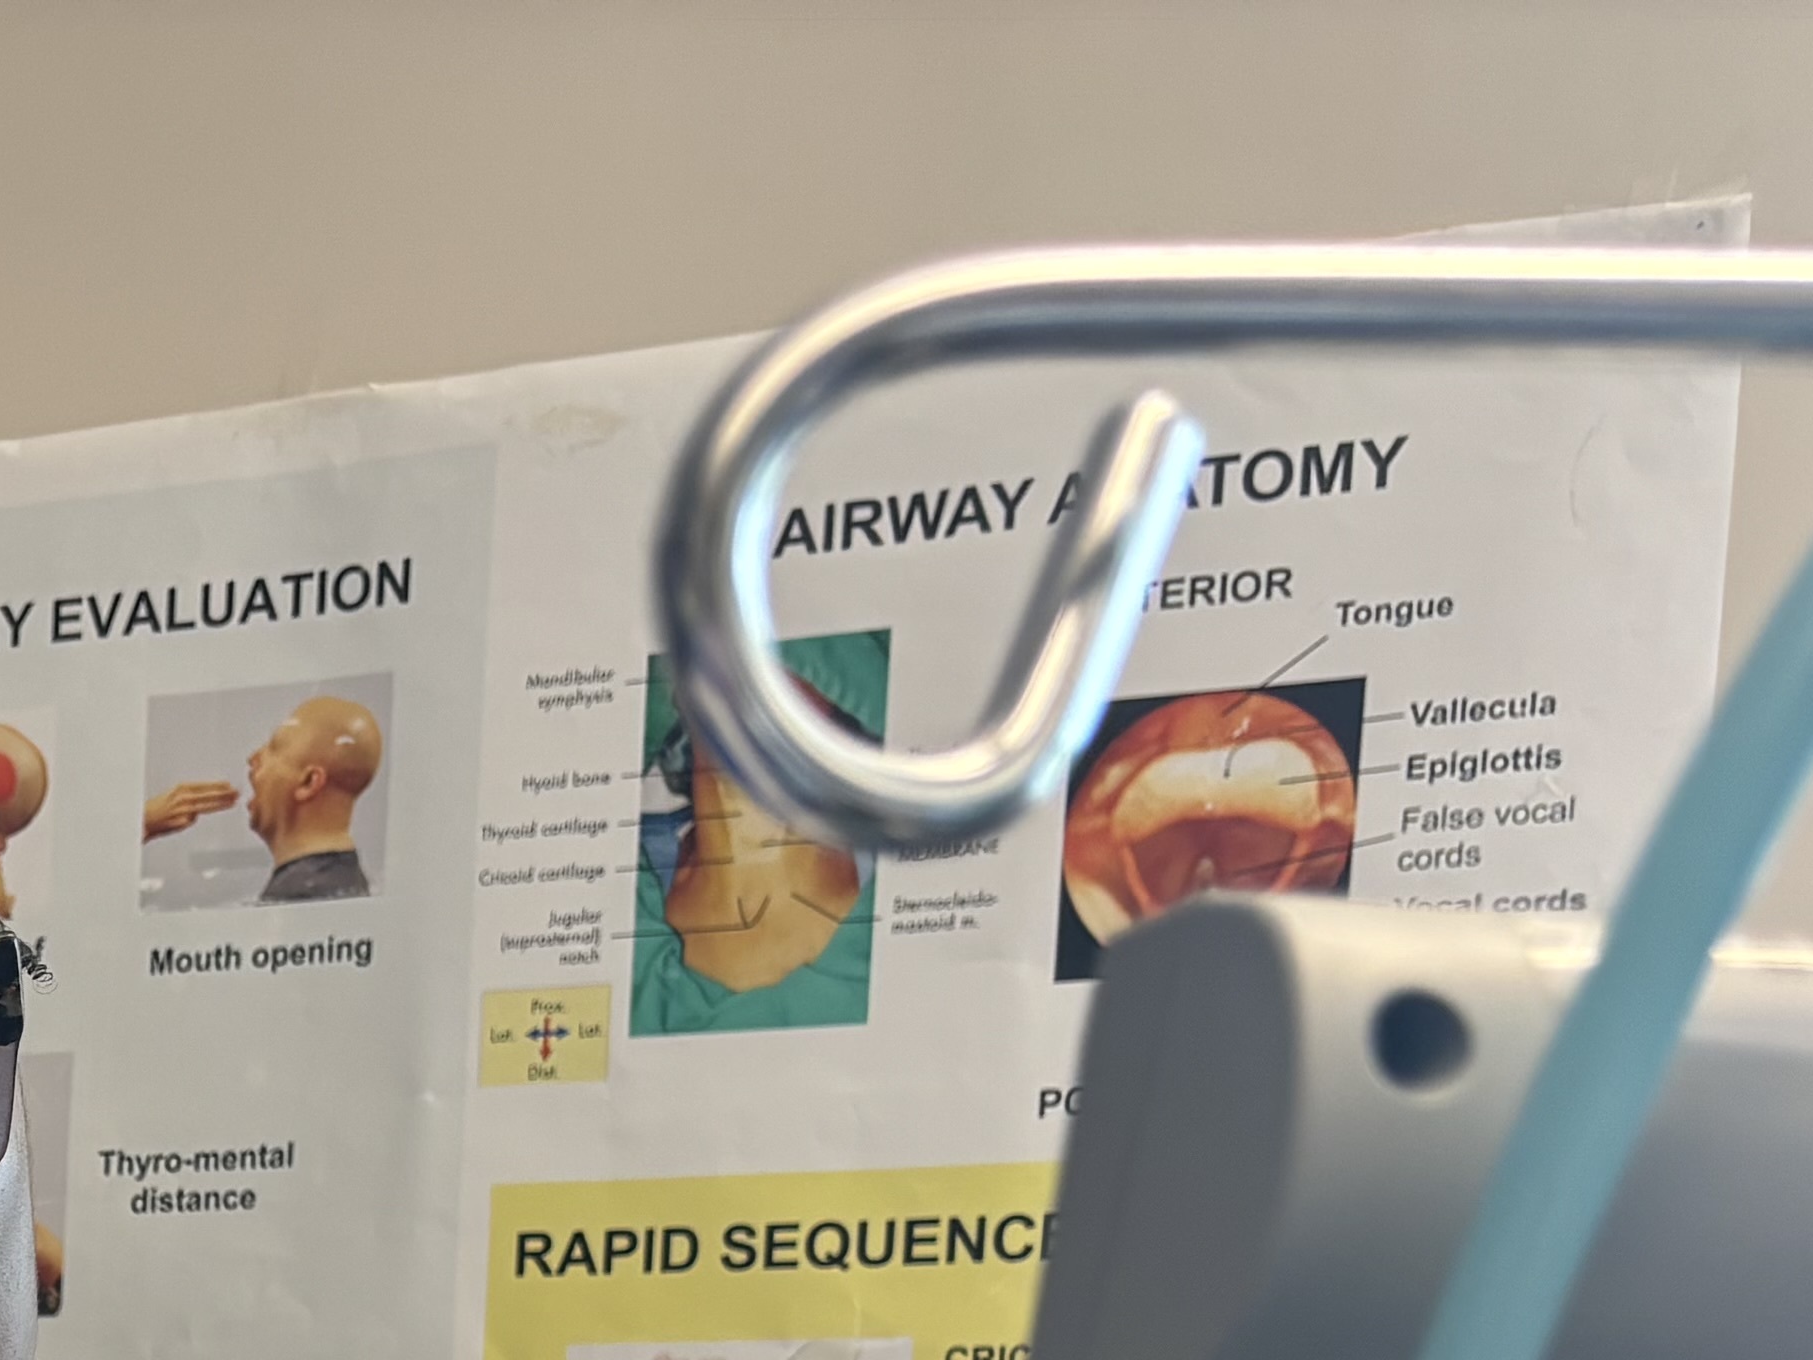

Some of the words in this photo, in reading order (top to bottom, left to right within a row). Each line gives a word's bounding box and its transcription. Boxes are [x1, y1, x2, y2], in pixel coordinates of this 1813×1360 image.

[772, 477, 1035, 559] AIRWAY
[1046, 434, 1409, 525] ATOMY
[51, 557, 412, 643] EVALUATION
[1336, 592, 1454, 628] Tongue
[1410, 691, 1556, 728] Vallecula
[1404, 744, 1562, 784] Epiglottis
[1401, 804, 1484, 834] False
[1495, 795, 1576, 826] vocal
[1397, 841, 1481, 872] cords
[1493, 888, 1588, 912] cords
[149, 943, 242, 975] Mouth
[252, 936, 373, 972] opening
[98, 1140, 295, 1181] Thyro-mental
[130, 1186, 257, 1214] distance
[514, 1226, 699, 1278] RAPID
